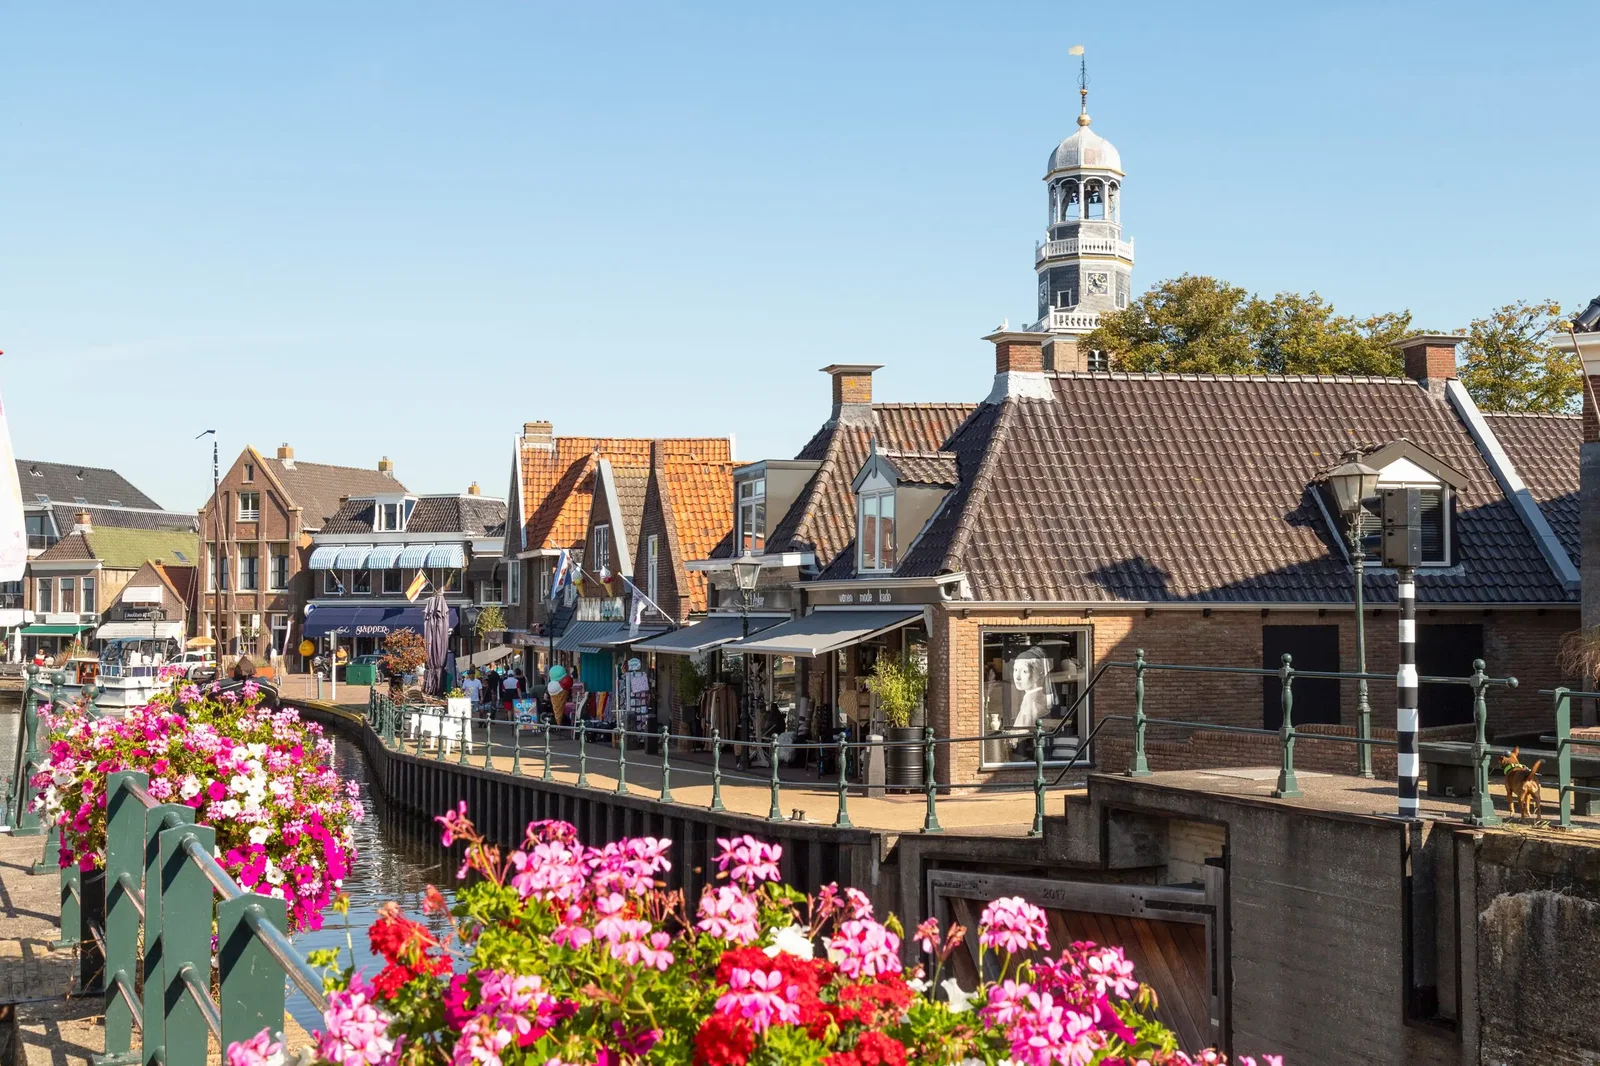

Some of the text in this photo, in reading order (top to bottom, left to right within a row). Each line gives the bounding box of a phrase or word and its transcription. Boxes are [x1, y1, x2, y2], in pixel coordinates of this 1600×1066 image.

[860, 589, 872, 602] mode
[879, 589, 891, 602] kado
[1043, 888, 1066, 900] 2017
